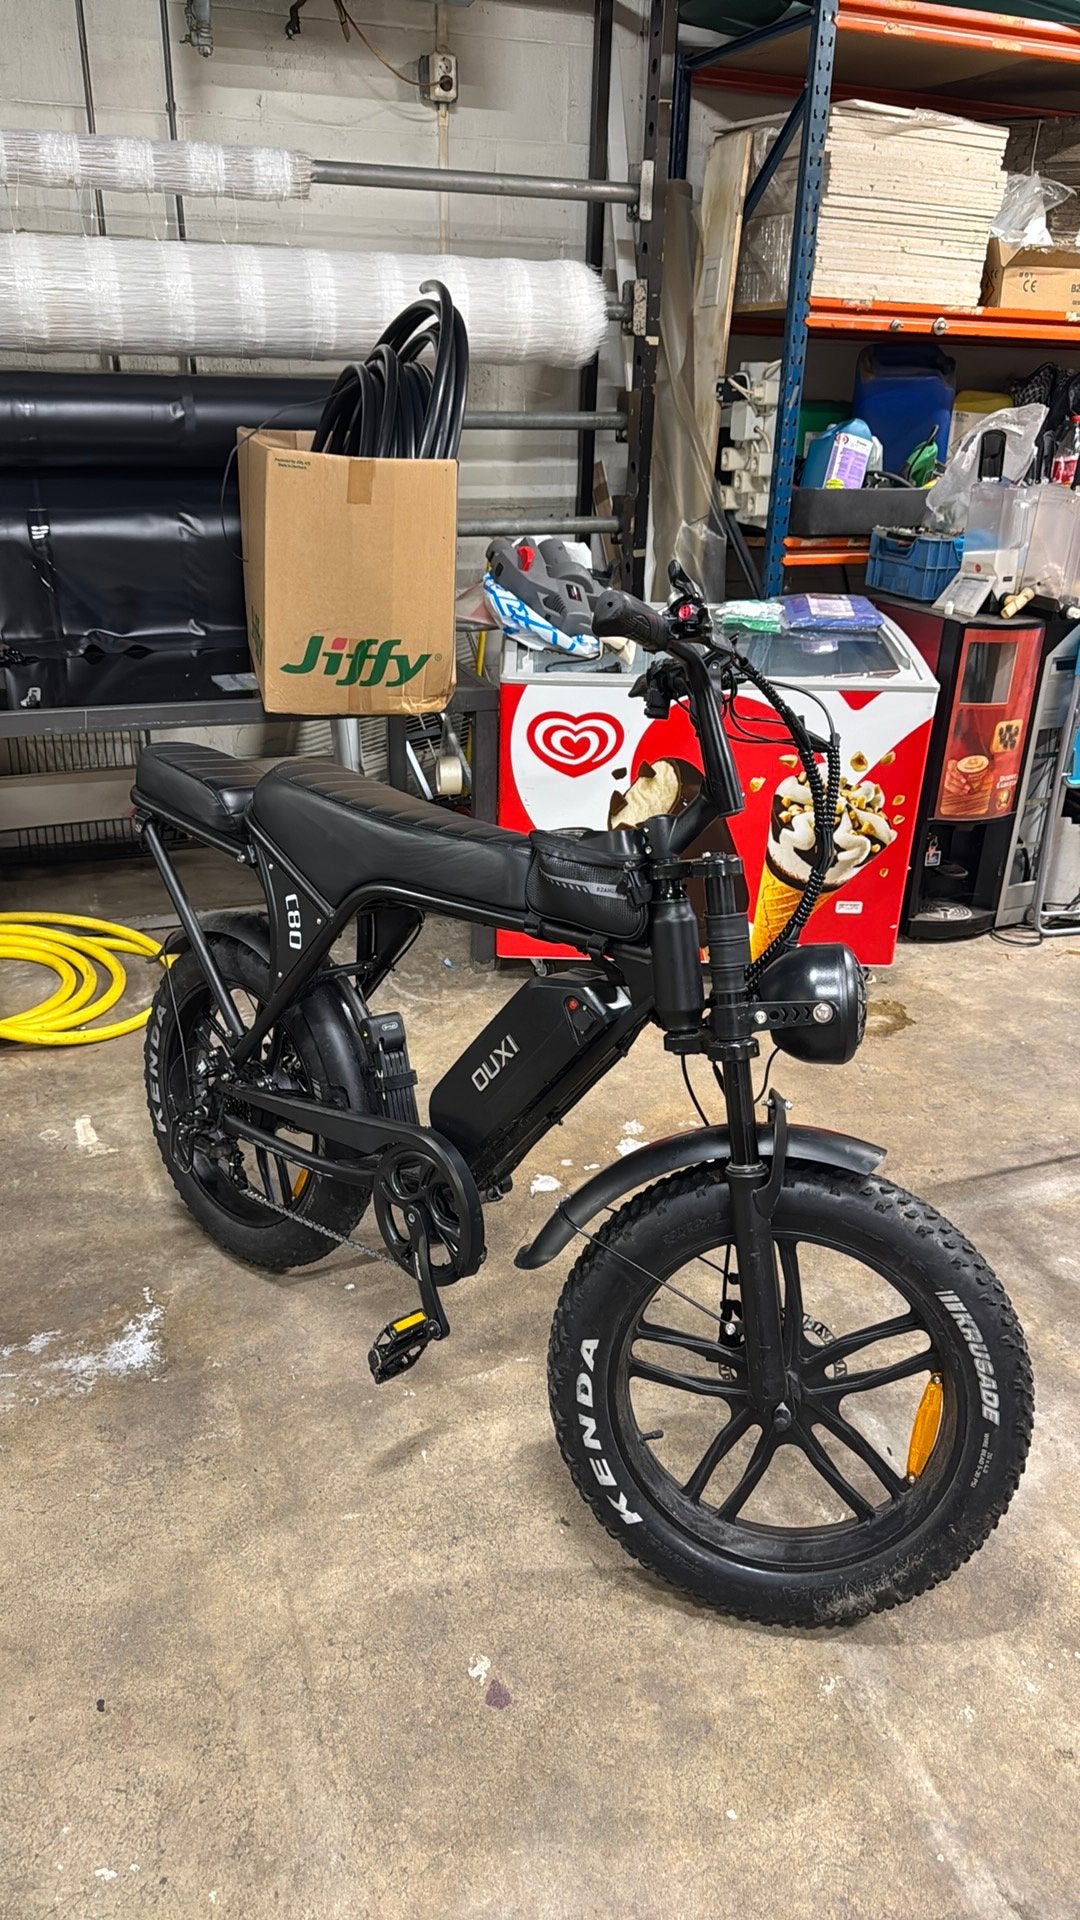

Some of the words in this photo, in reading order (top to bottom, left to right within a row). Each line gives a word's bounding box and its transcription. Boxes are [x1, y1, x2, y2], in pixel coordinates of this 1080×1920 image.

[279, 635, 432, 687] Jiffy
[285, 894, 302, 950] C80
[148, 1004, 168, 1133] KENDA
[471, 1034, 520, 1092] OUXI
[949, 1311, 1001, 1427] KRUSADE
[576, 1338, 644, 1526] KENDA
